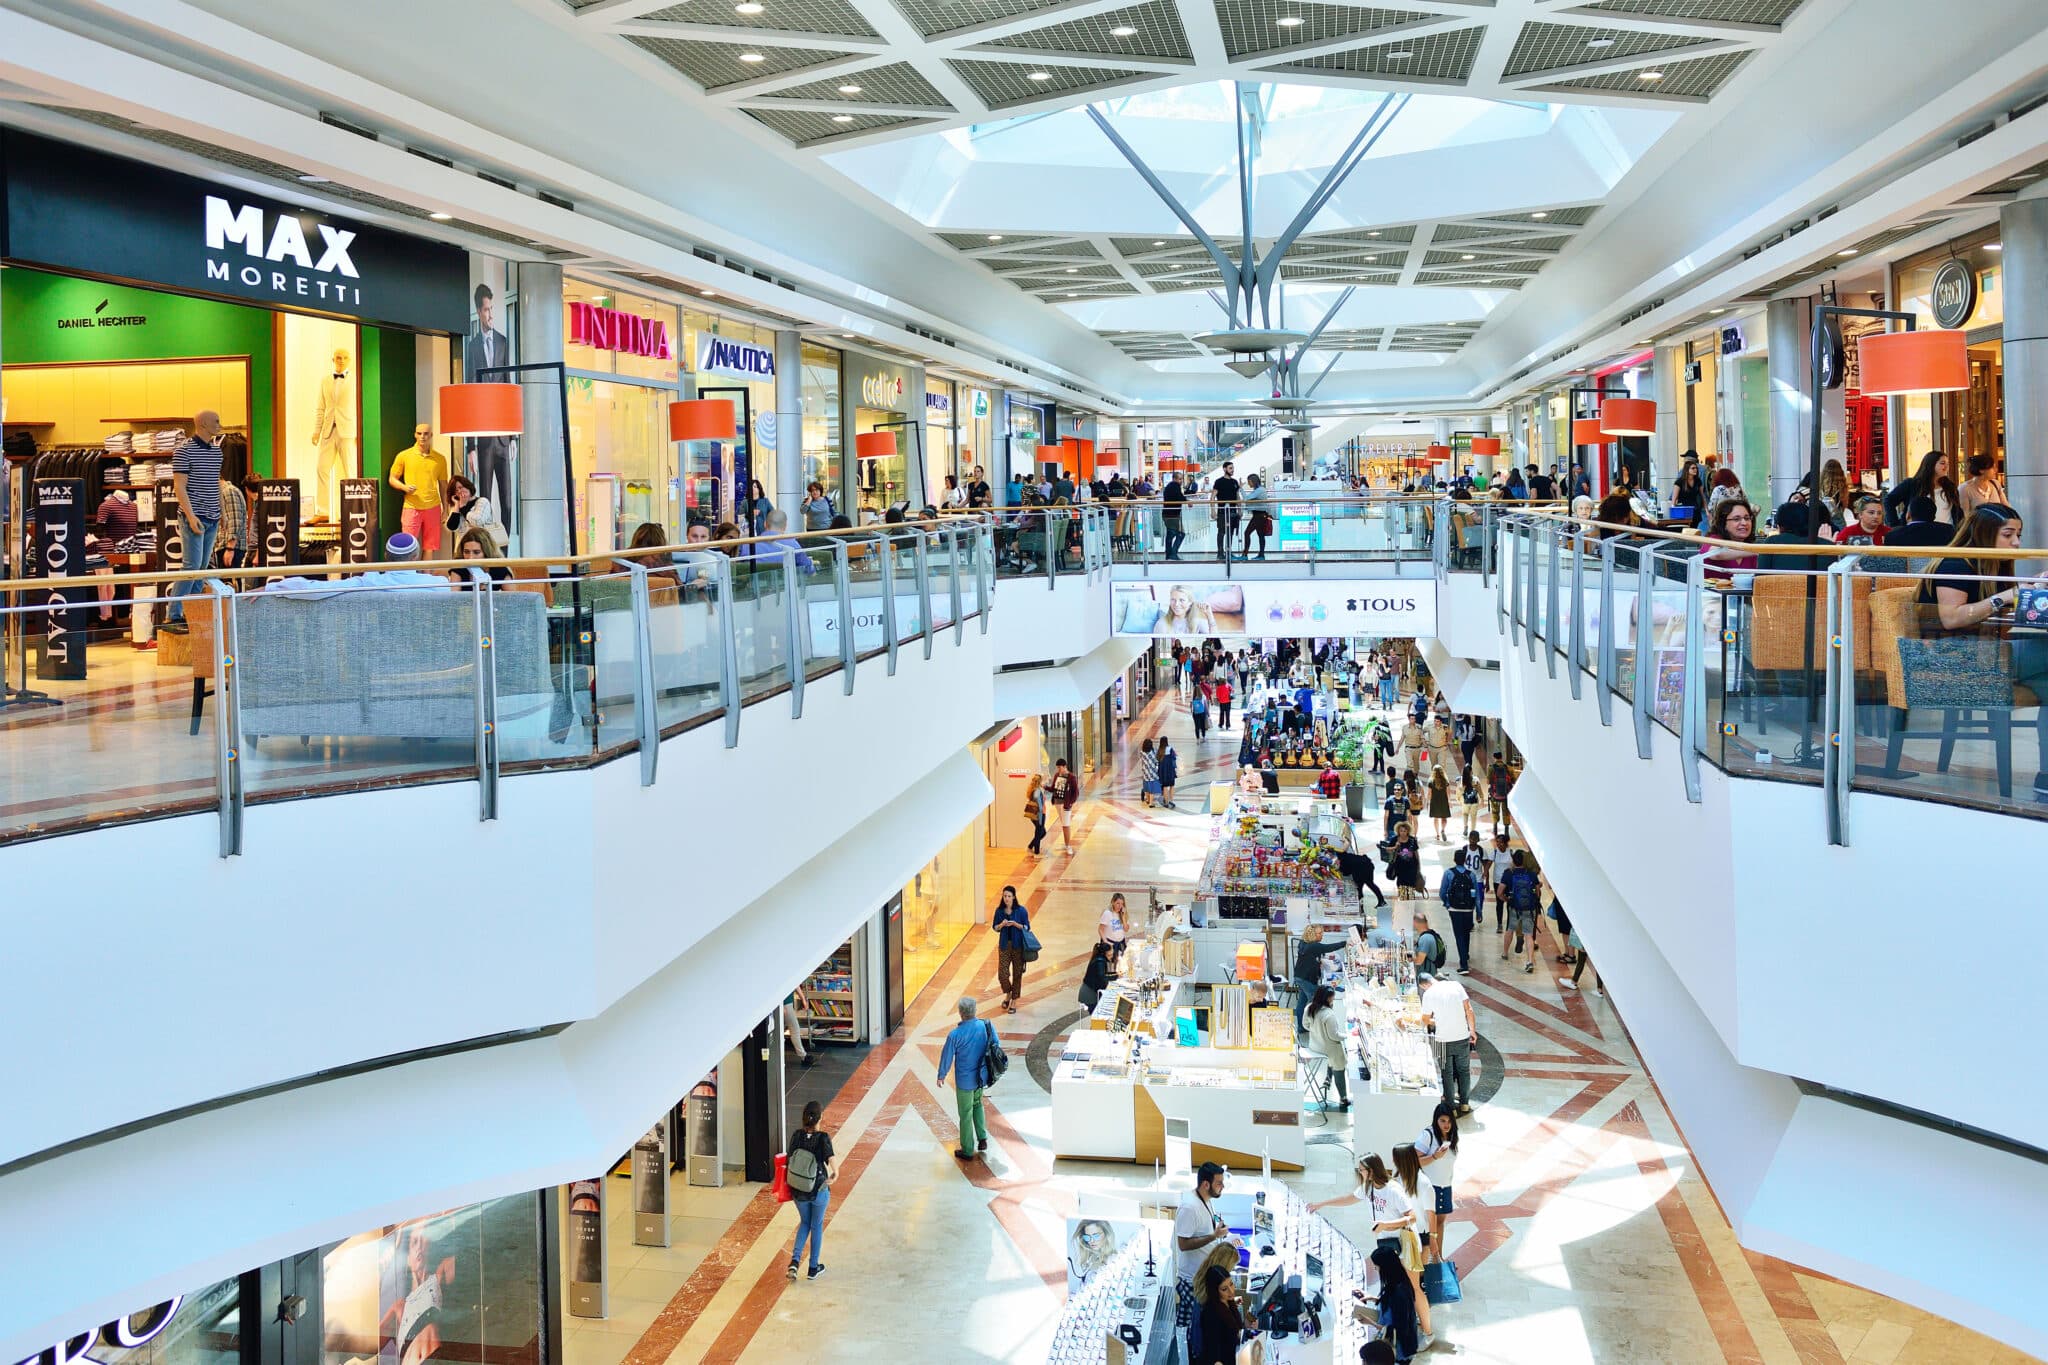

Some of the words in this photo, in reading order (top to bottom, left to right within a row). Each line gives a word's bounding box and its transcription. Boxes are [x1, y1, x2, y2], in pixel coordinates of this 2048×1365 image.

[205, 195, 361, 279] MAX
[206, 258, 361, 306] MORETTI
[58, 318, 95, 329] DANIEL
[98, 316, 147, 327] HECHTER
[569, 301, 673, 361] INTIMA
[715, 341, 776, 376] NAUTICA
[39, 486, 73, 497] MAX
[262, 485, 292, 494] MAX
[344, 484, 372, 492] MAX
[266, 514, 287, 585] POL
[349, 511, 368, 569] POL
[45, 520, 69, 664] POLGAT
[1359, 598, 1416, 612] TOUS
[1466, 854, 1481, 870] 40
